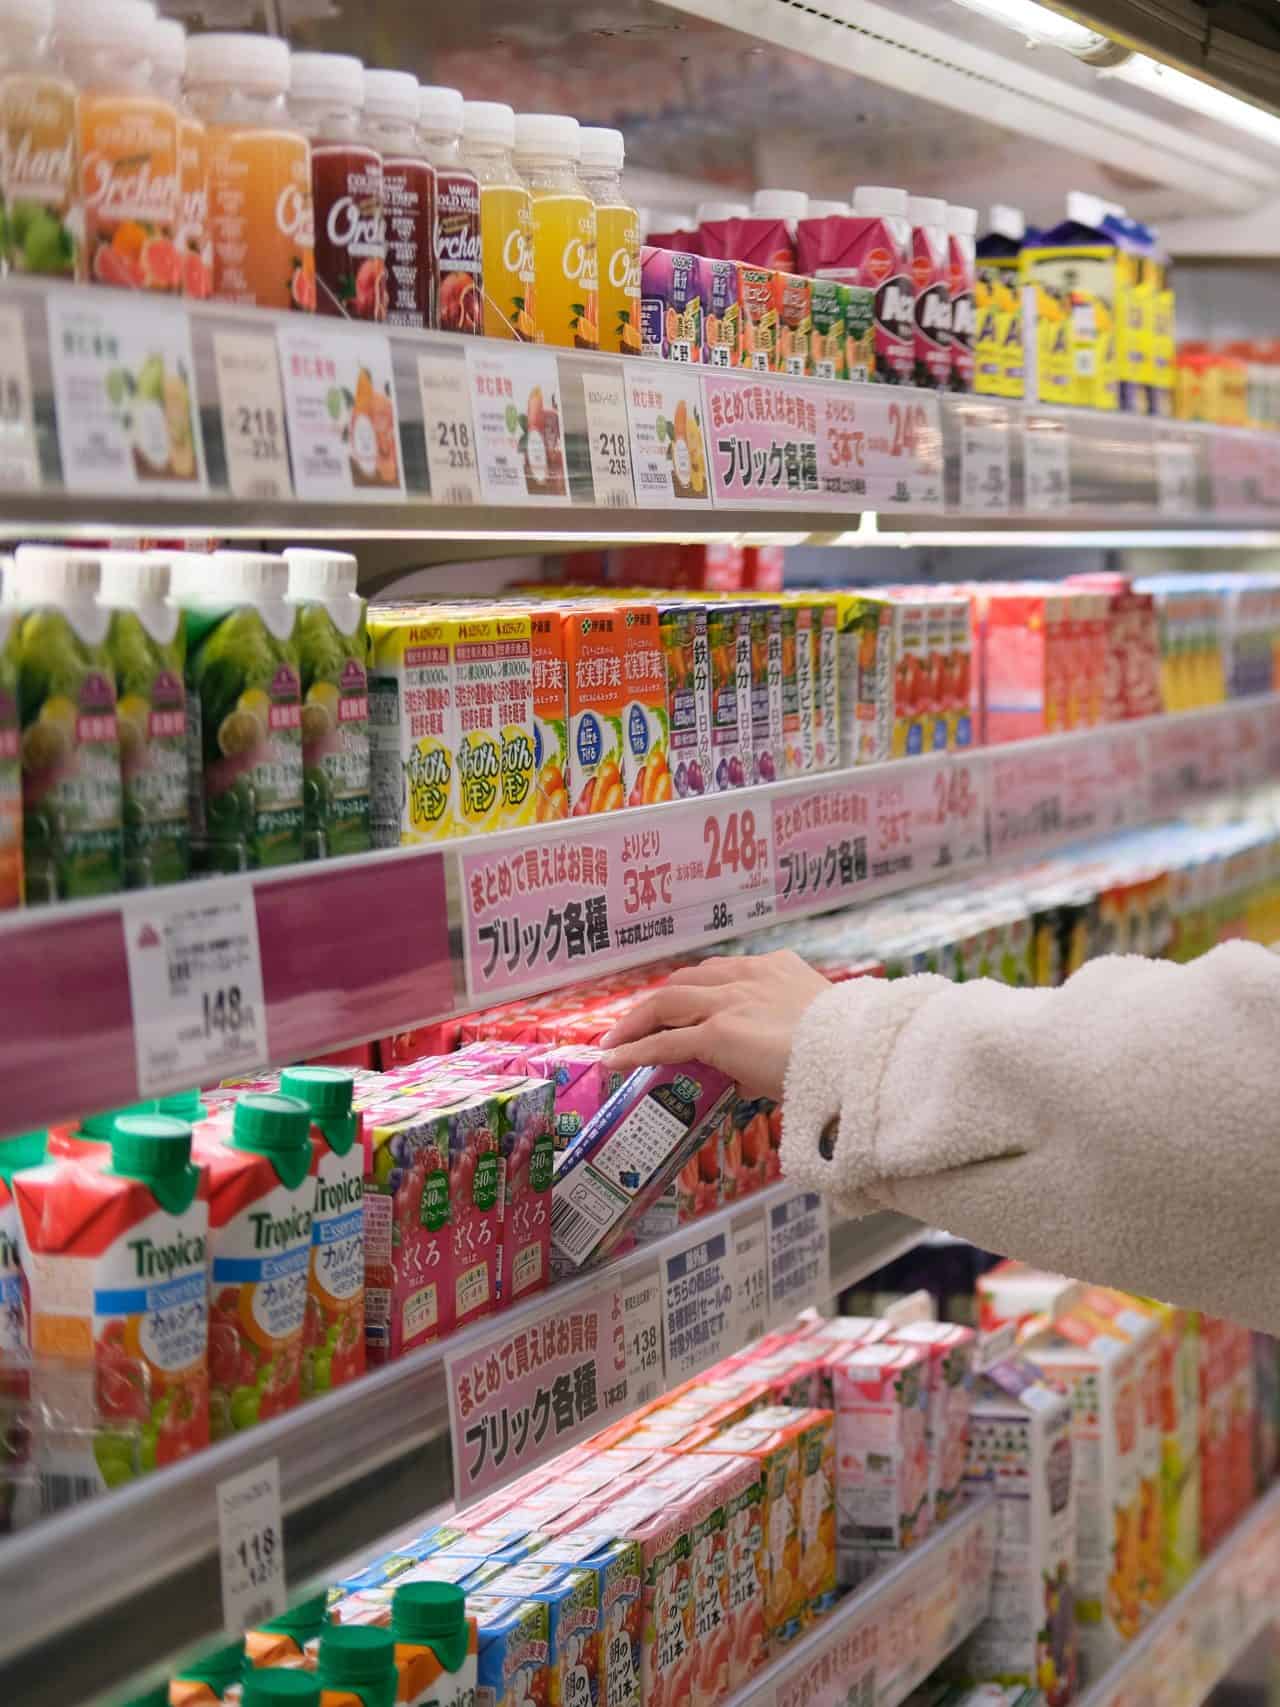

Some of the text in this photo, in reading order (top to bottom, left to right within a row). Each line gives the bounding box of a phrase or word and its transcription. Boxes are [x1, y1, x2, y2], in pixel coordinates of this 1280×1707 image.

[437, 421, 469, 447] 218
[600, 432, 625, 457] 218
[717, 437, 819, 491] ブリック各種
[575, 657, 622, 689] 充実野菜
[623, 648, 664, 680] 充実野菜
[798, 632, 813, 769] マルチビタミン
[461, 780, 497, 816] レモン
[621, 829, 661, 863] よりどり
[469, 845, 609, 914] まとめて買えばお買得
[779, 835, 869, 899] ブリック各種
[624, 862, 673, 914] 3本で
[478, 894, 611, 979] ブリック各種
[512, 1199, 546, 1234] ざくろ
[454, 1218, 492, 1256] ざくろ
[402, 1239, 441, 1278] ざくろ
[633, 1326, 657, 1357] 138
[456, 1310, 599, 1417] まとめて買えばお買得
[465, 1359, 599, 1481] ブリック各種
[236, 1527, 275, 1568] 118
